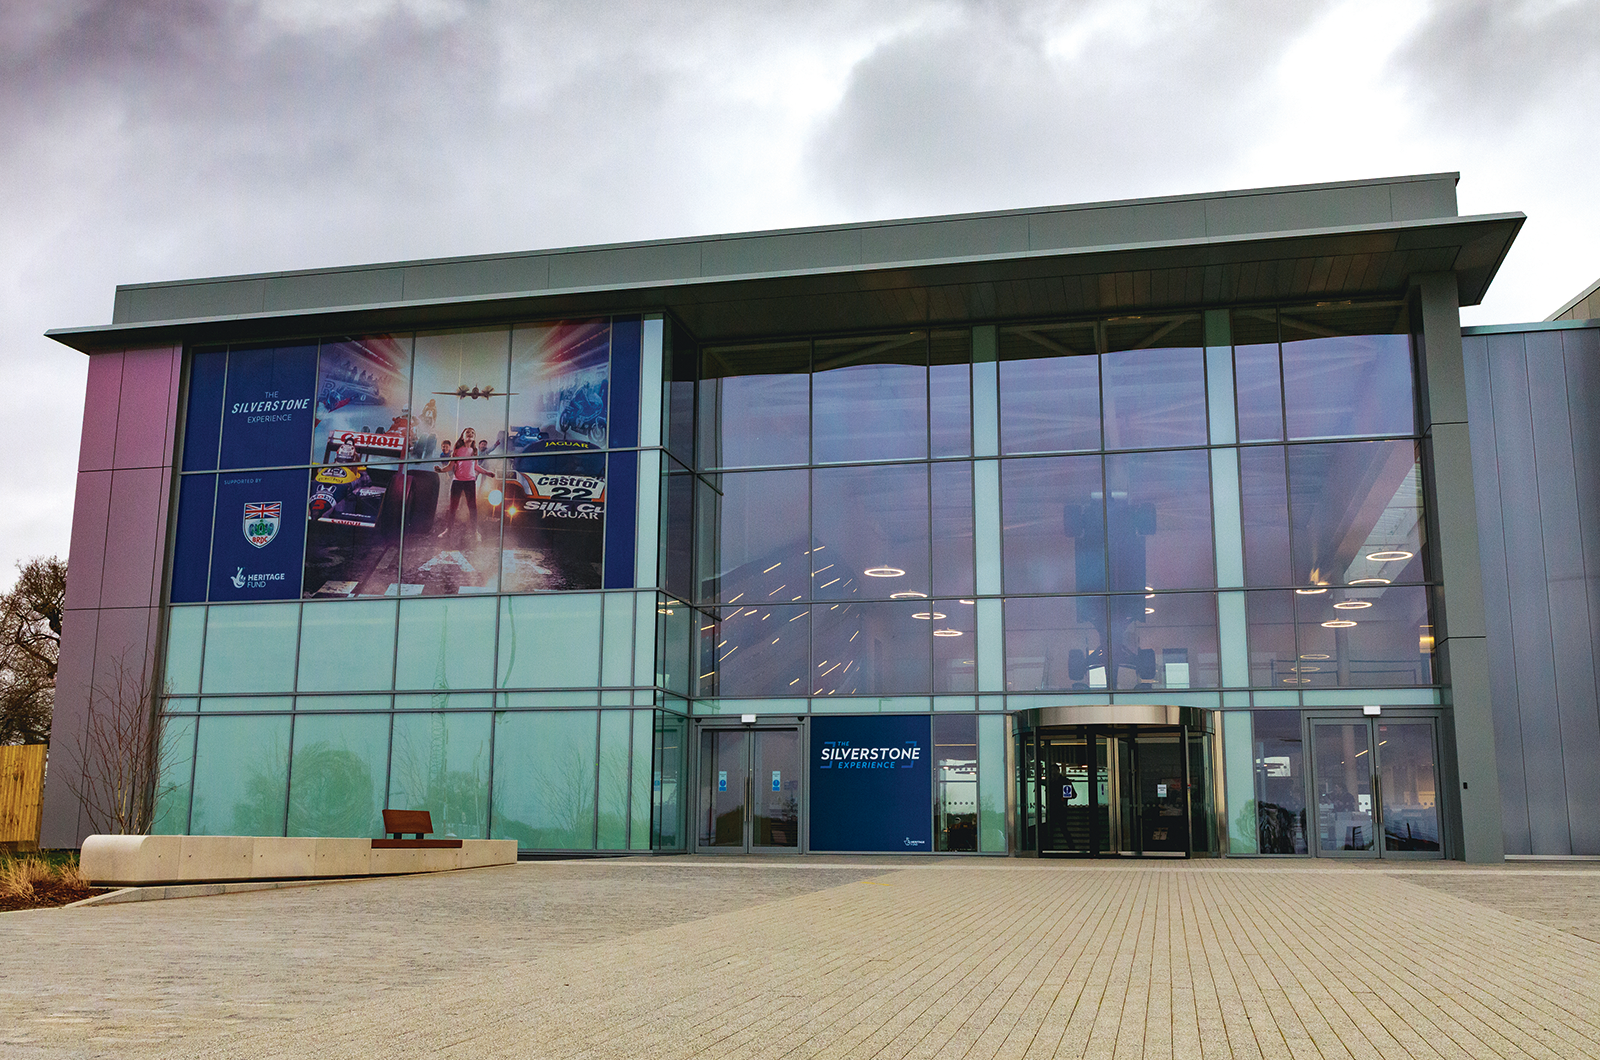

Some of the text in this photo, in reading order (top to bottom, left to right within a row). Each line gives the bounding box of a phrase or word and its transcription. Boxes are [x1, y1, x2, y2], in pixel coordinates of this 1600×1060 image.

[264, 391, 279, 399] THE
[231, 398, 310, 414] SILVERSTONE
[247, 414, 292, 424] EXPERIENCE
[340, 432, 400, 448] Canon
[545, 441, 589, 449] JAGUAR
[537, 476, 599, 489] Castrol
[550, 487, 593, 502] 22
[312, 499, 327, 510] 5
[523, 501, 570, 512] Silk
[541, 510, 599, 520] JAGUAR
[252, 536, 269, 545] BRDC
[247, 573, 285, 581] HERITAGE
[820, 747, 921, 760] SILVERSTONE
[837, 761, 896, 769] EXPERIENCE
